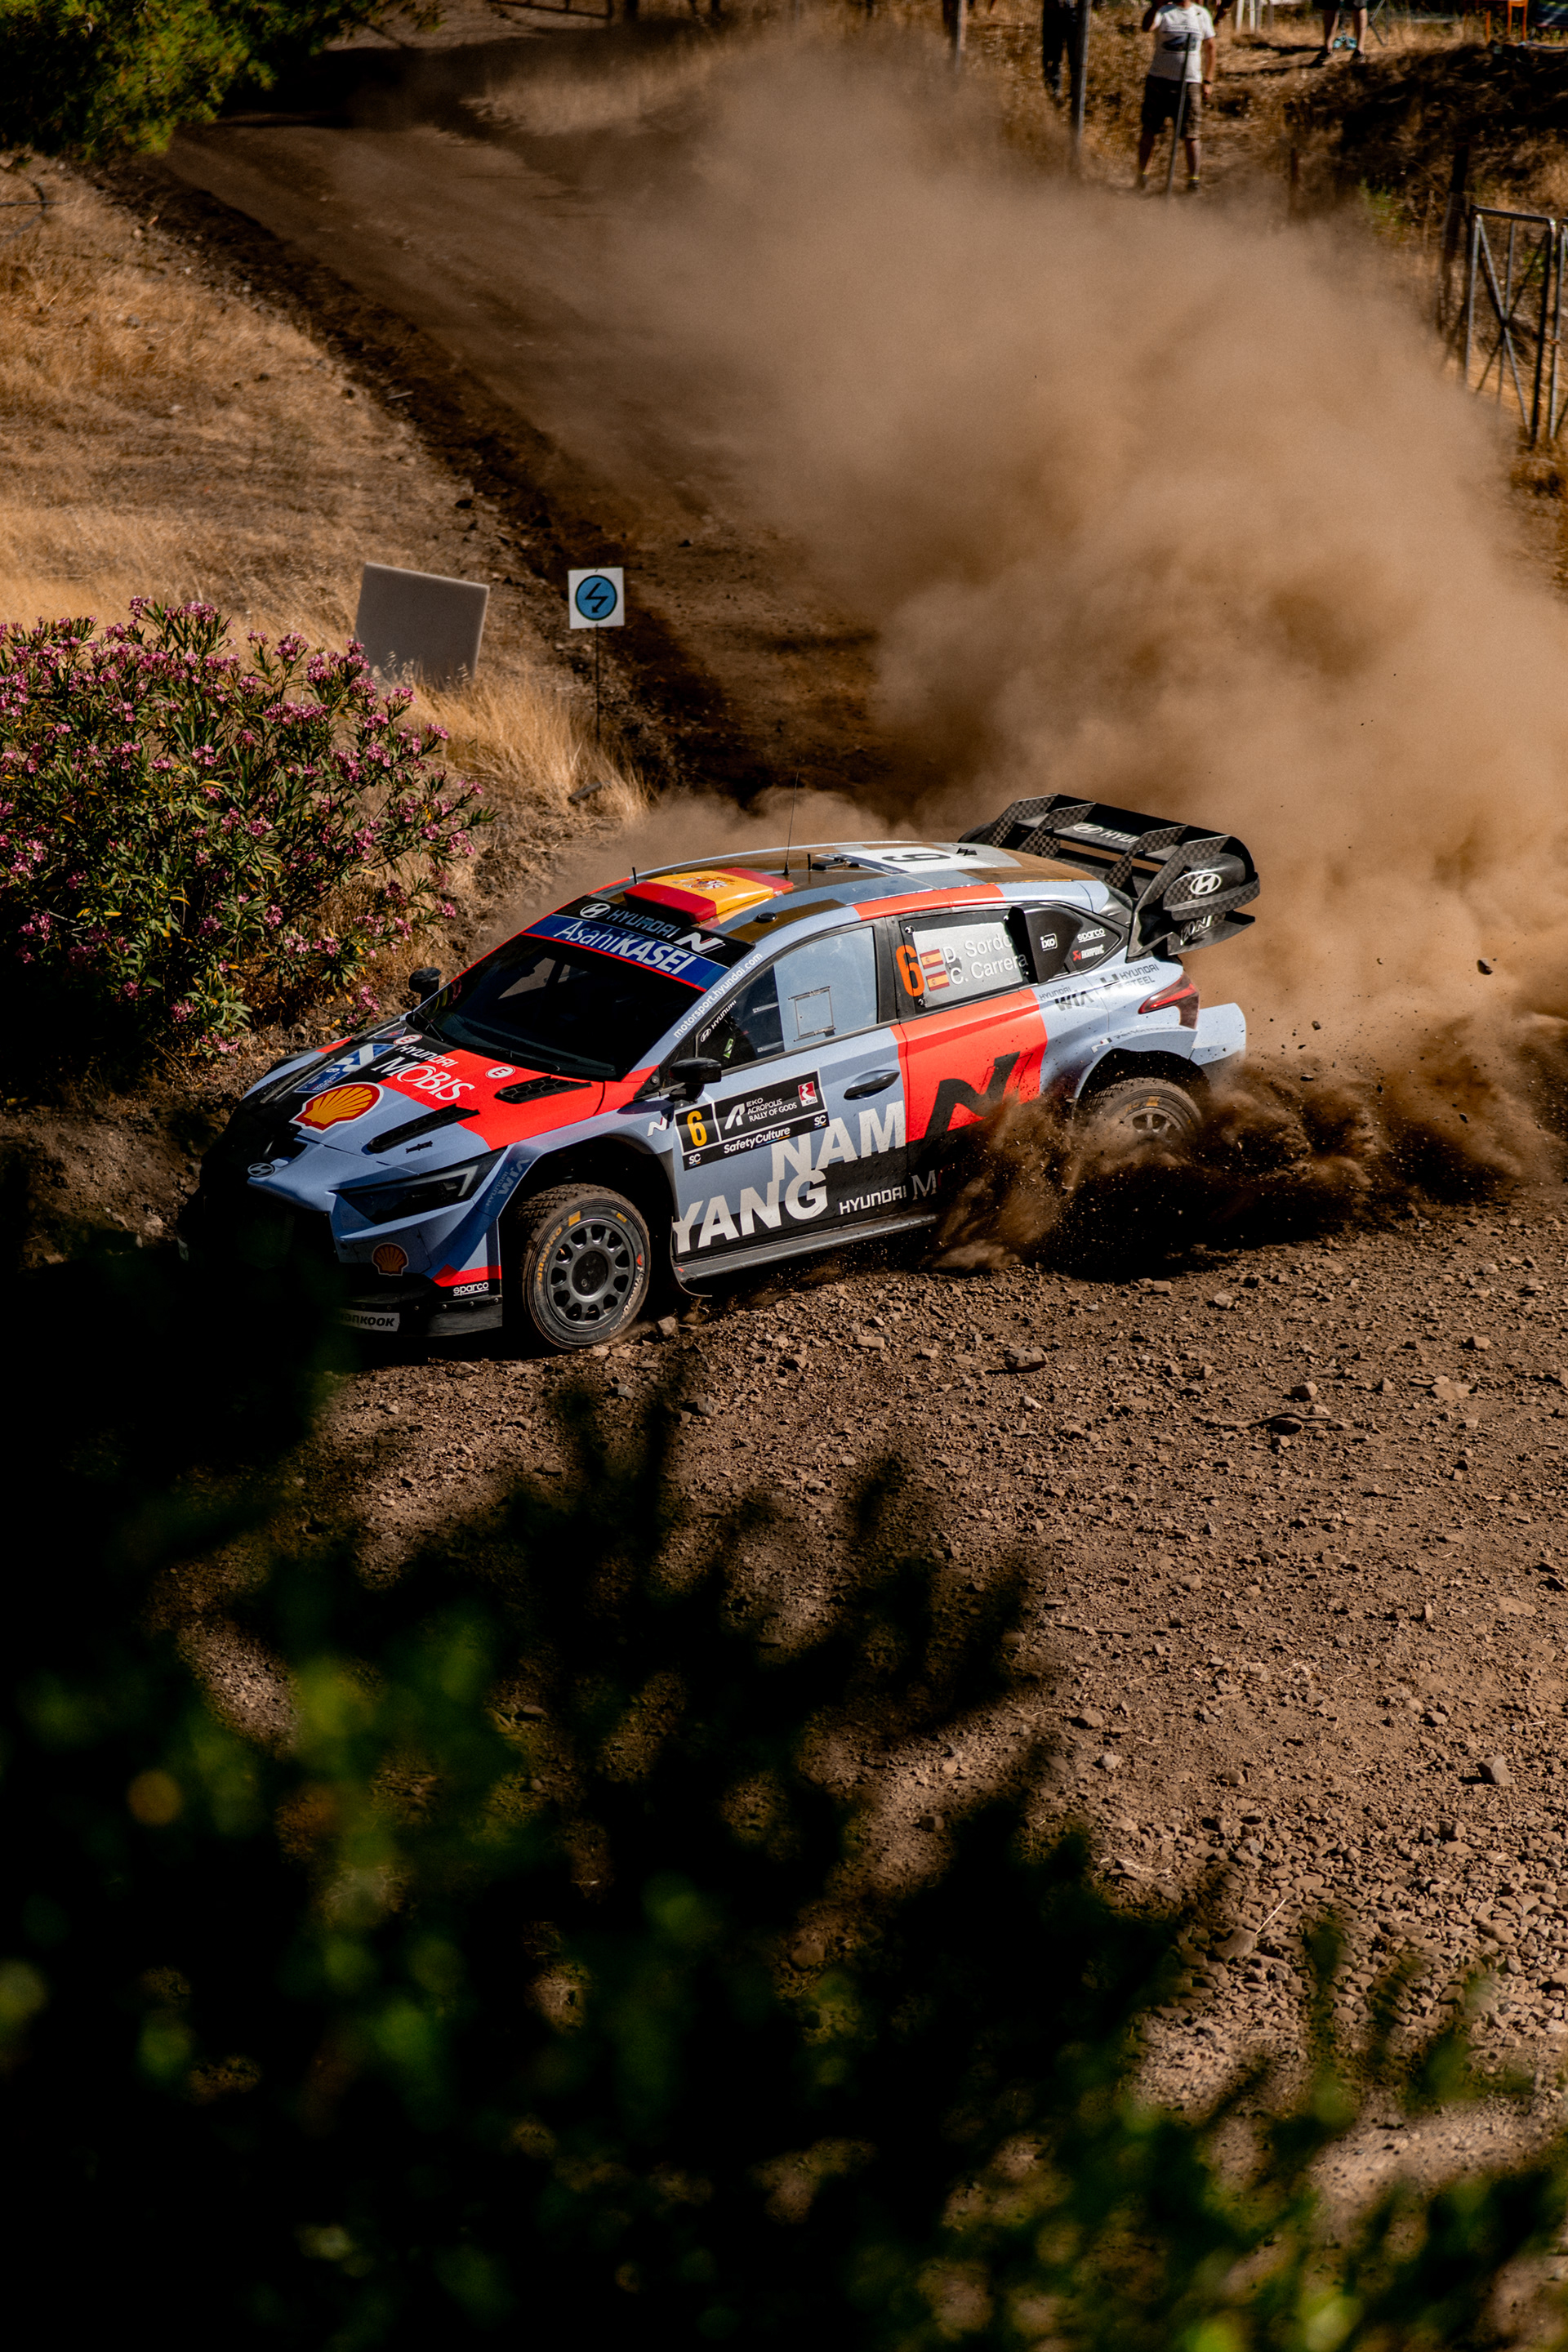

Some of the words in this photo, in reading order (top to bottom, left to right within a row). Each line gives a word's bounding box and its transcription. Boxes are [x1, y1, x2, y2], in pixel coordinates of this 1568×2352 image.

[606, 909, 682, 938] HYUNDAI
[1076, 929, 1106, 943] sparco
[942, 946, 962, 964] D.
[895, 944, 925, 997] 6
[950, 967, 969, 985] C.
[970, 953, 1029, 979] Carrera
[1119, 964, 1160, 980] HYUNDAI
[673, 952, 763, 1039] motorsport.hyundai.com
[1038, 986, 1072, 1001] HYUNDAI
[396, 1044, 460, 1068] HYUNDAI
[372, 1056, 475, 1101] MOBIS
[746, 1098, 764, 1108] EKO
[747, 1098, 782, 1115] ACROPOLIS
[749, 1111, 768, 1123] RALLY
[768, 1108, 778, 1117] OF
[779, 1102, 798, 1114] GODS
[687, 1110, 707, 1147] 6
[814, 1115, 826, 1126] SC
[724, 1127, 791, 1154] SafetyCulture
[772, 1100, 906, 1183] NAM
[688, 1153, 701, 1165] SC
[486, 1171, 510, 1207] HYUNDAI
[839, 1185, 906, 1215] HYUNDAI
[672, 1169, 828, 1254] YANG
[453, 1281, 489, 1296] sparco
